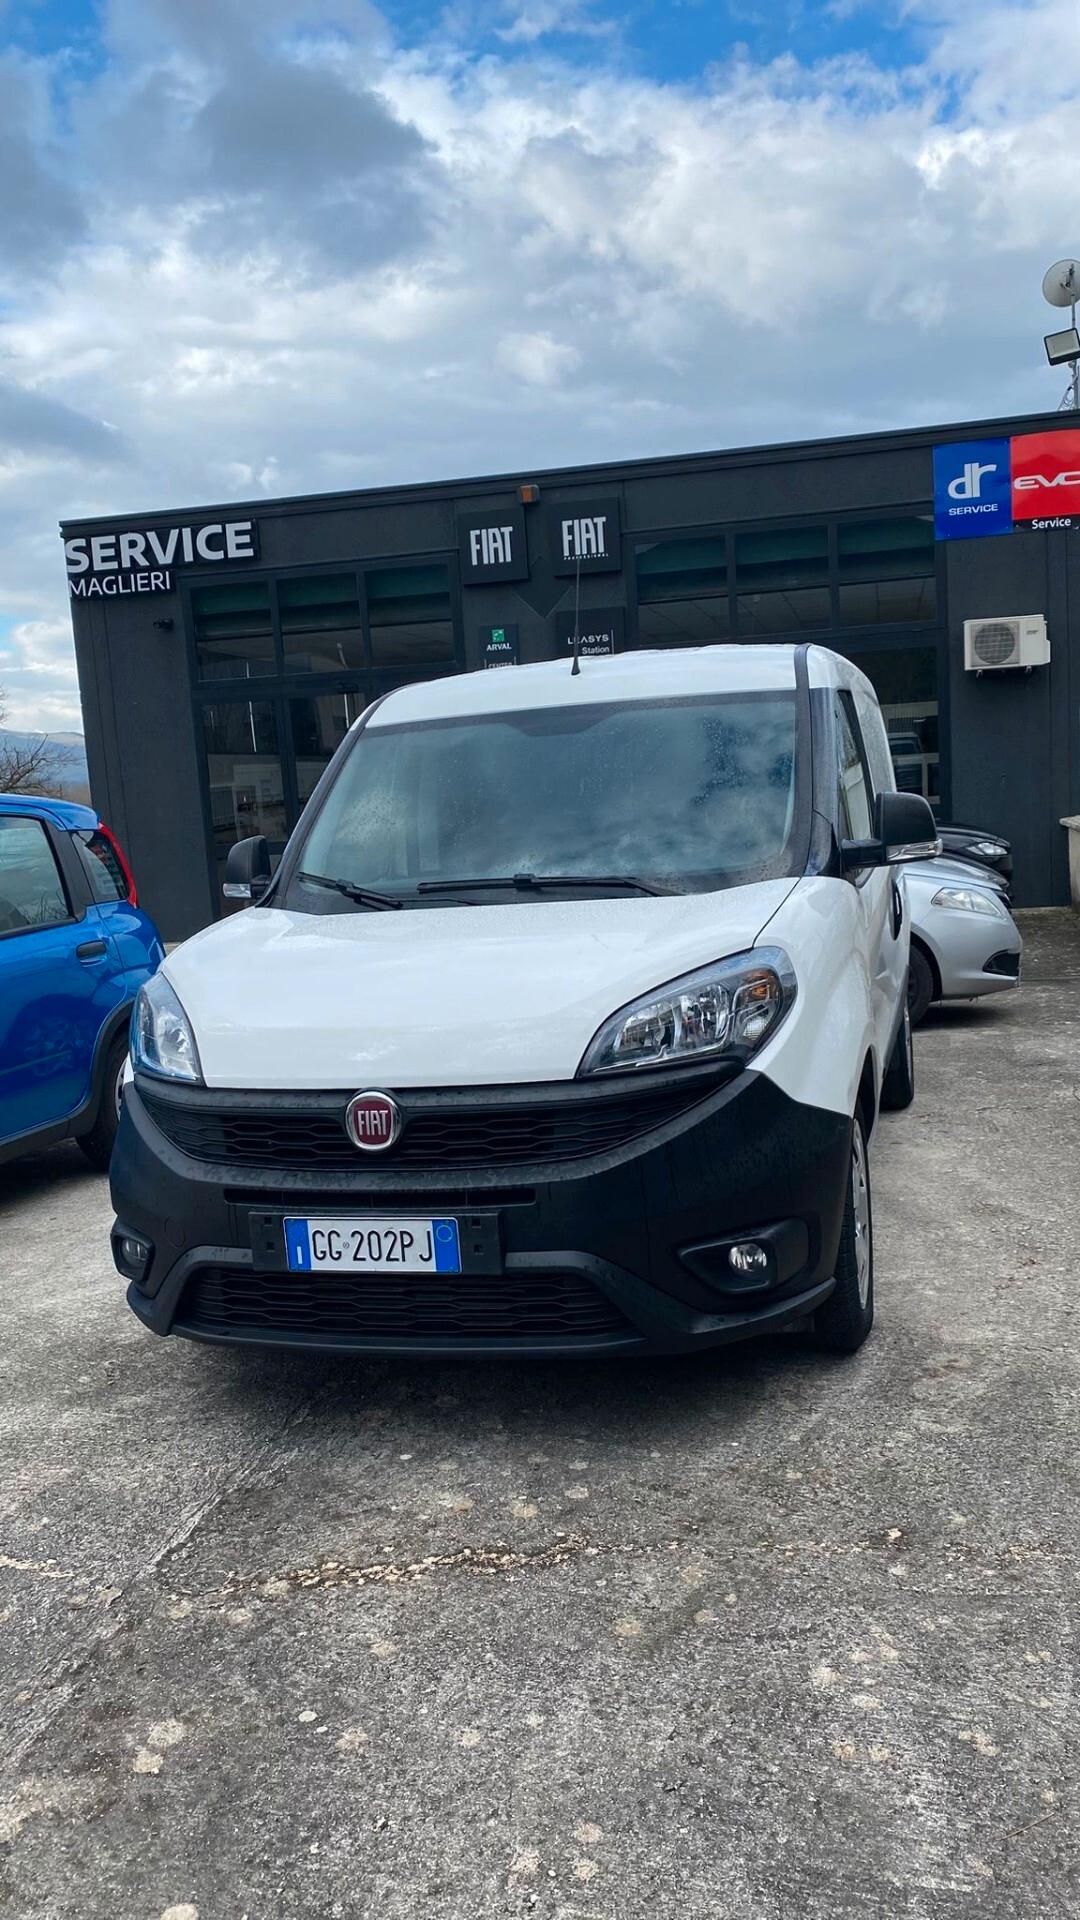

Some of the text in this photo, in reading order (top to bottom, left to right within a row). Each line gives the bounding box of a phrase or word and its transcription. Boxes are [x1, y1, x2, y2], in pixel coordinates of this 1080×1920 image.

[948, 462, 997, 499] dr
[949, 503, 998, 516] SERVICE
[561, 516, 607, 557] FIAT
[1031, 517, 1072, 530] Service
[64, 521, 254, 574] SERVICE
[469, 526, 513, 566] FIAT
[69, 571, 170, 598] MAGLIERI
[486, 642, 512, 652] ARVAL
[582, 646, 610, 656] Station
[357, 1110, 388, 1136] FIAT
